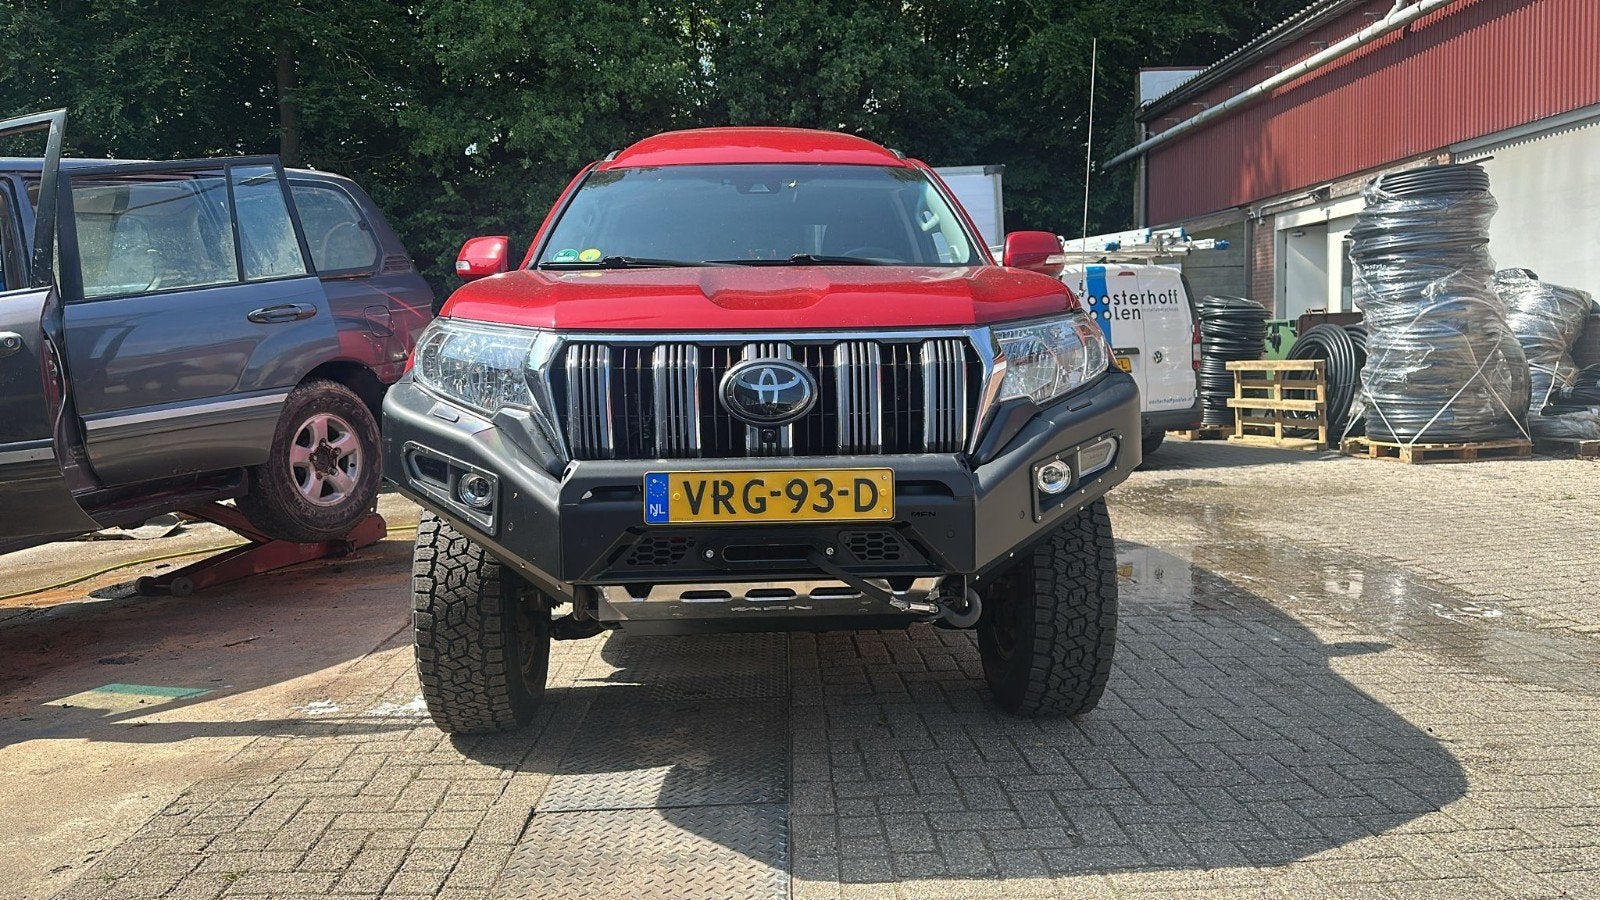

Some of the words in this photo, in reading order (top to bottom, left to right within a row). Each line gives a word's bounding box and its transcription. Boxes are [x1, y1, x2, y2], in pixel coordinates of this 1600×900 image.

[1088, 290, 1178, 306] oosterhoff
[683, 478, 878, 515] VRG-93-D
[650, 504, 666, 514] NL
